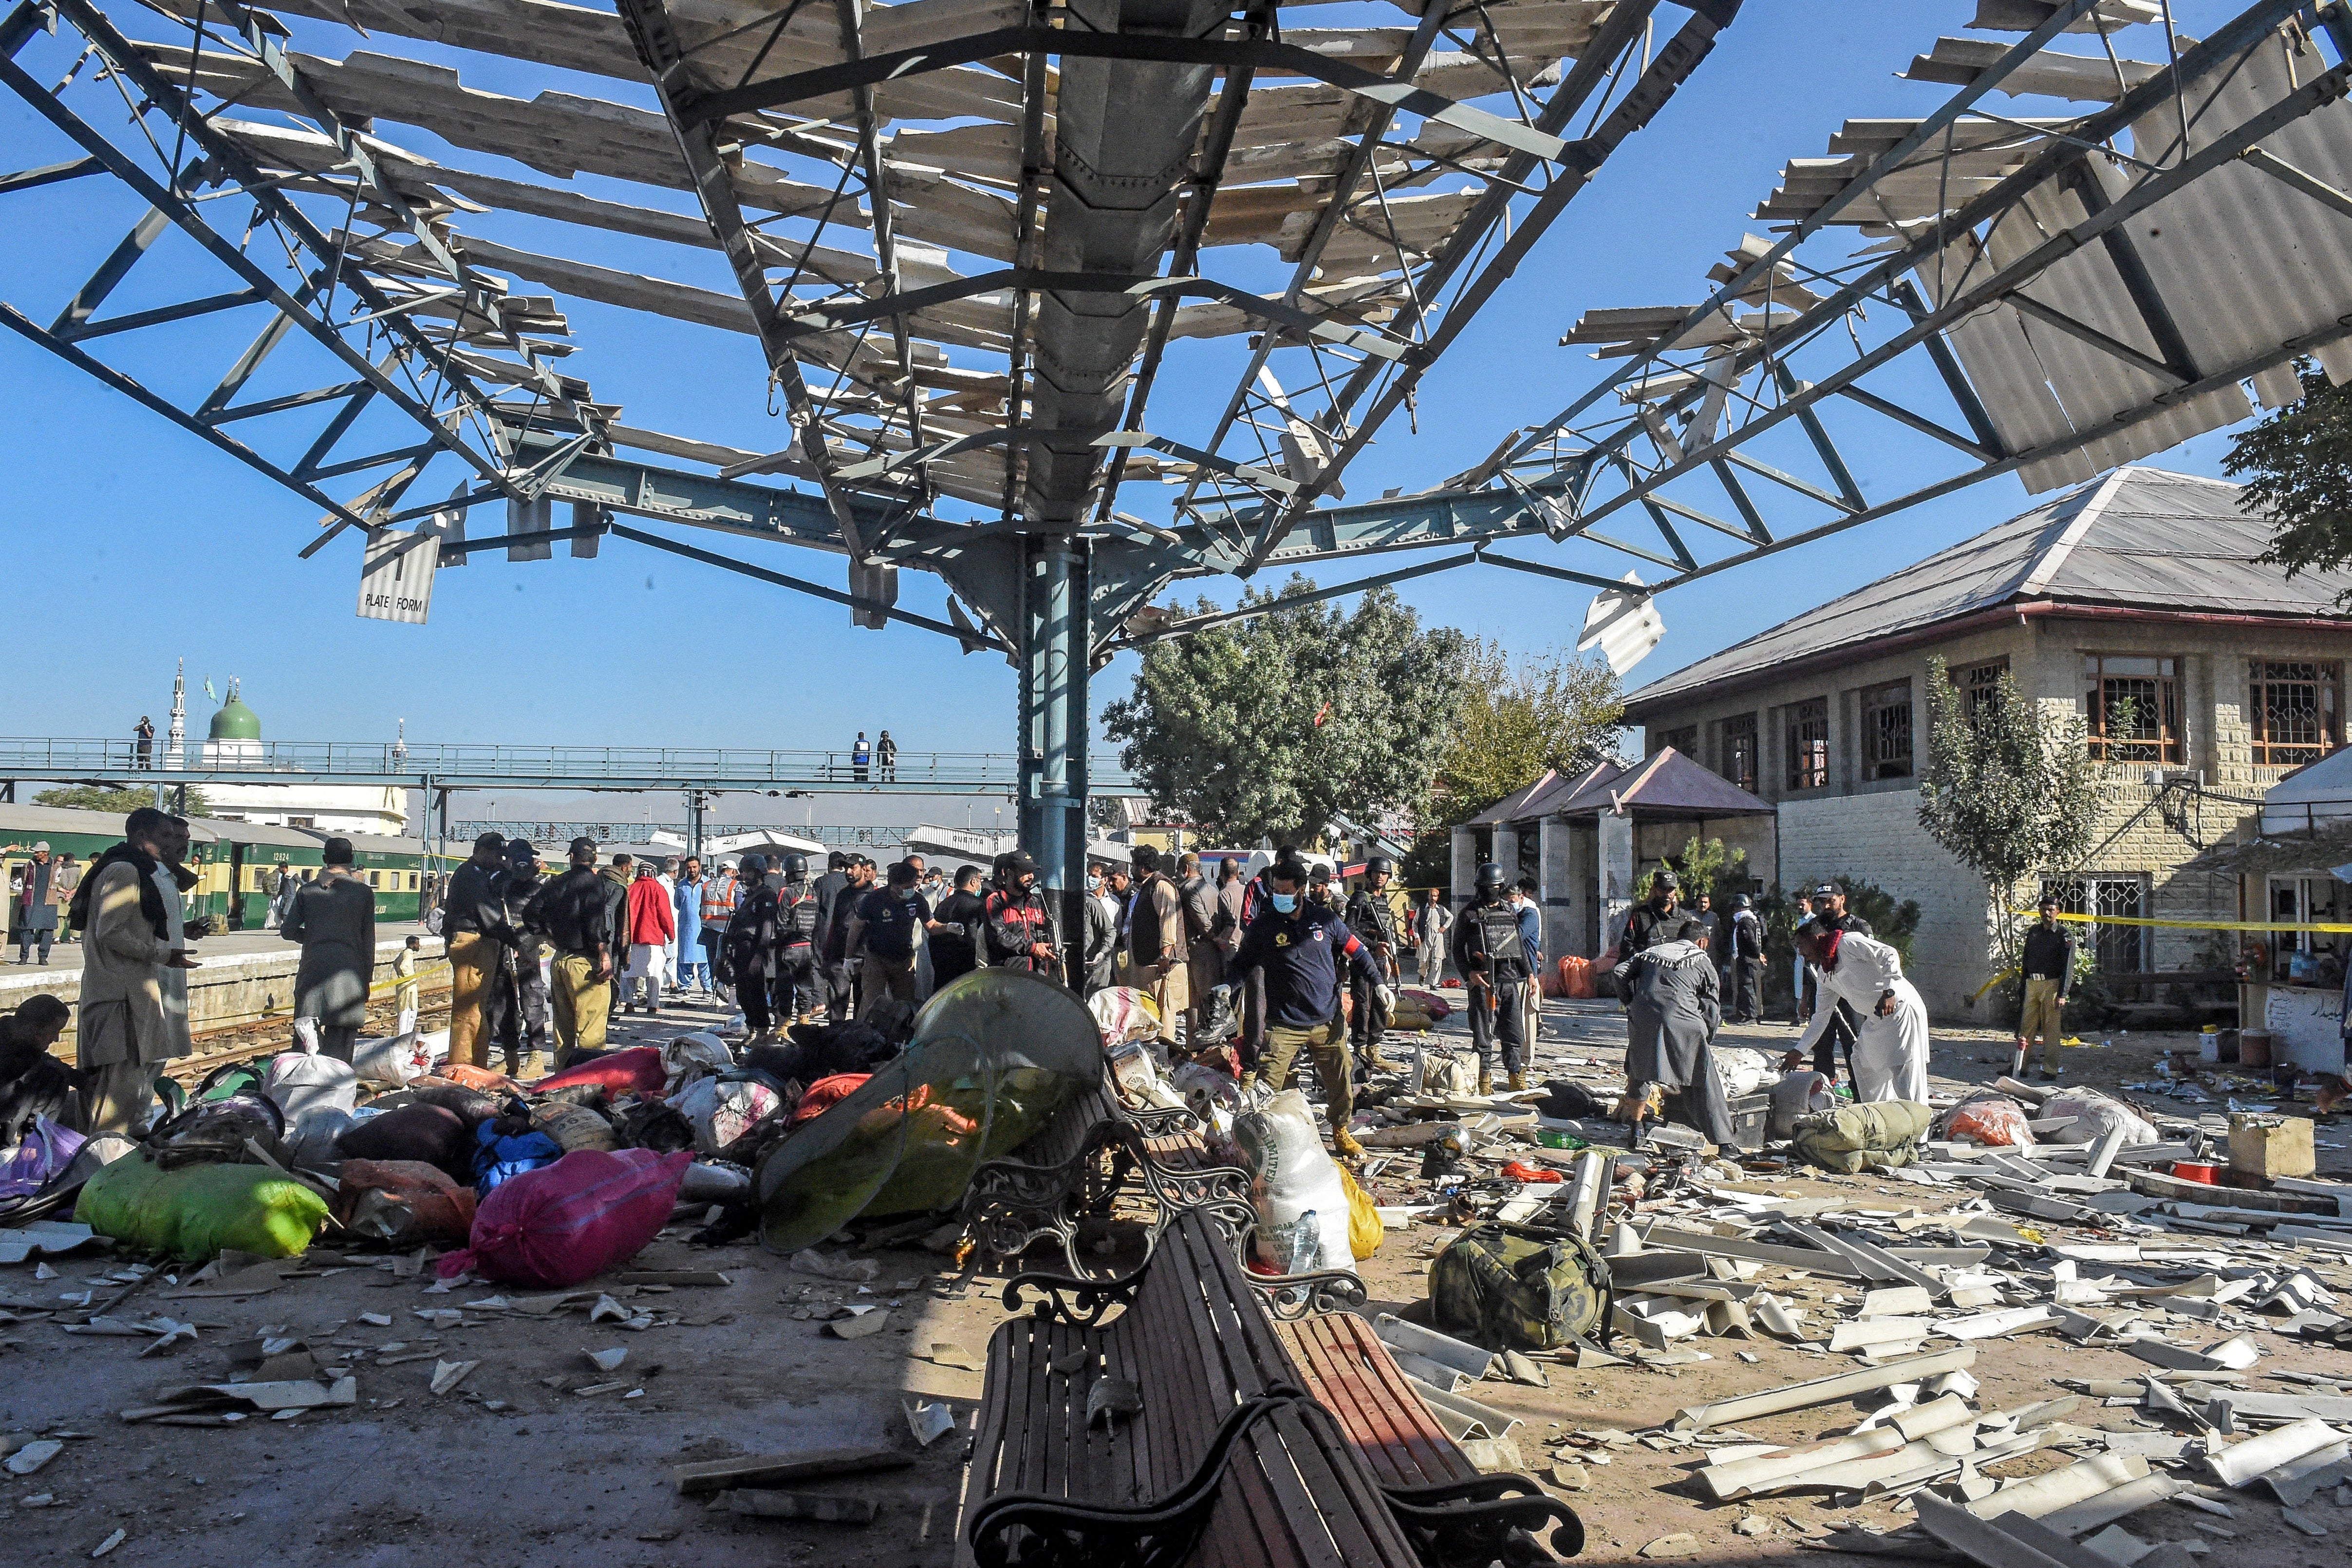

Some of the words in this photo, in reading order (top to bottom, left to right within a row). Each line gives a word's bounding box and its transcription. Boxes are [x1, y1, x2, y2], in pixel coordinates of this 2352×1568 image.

[366, 593, 390, 608] PLATE
[396, 597, 423, 613] FORM
[952, 835, 984, 845] QUETTA
[273, 852, 290, 861] 12824
